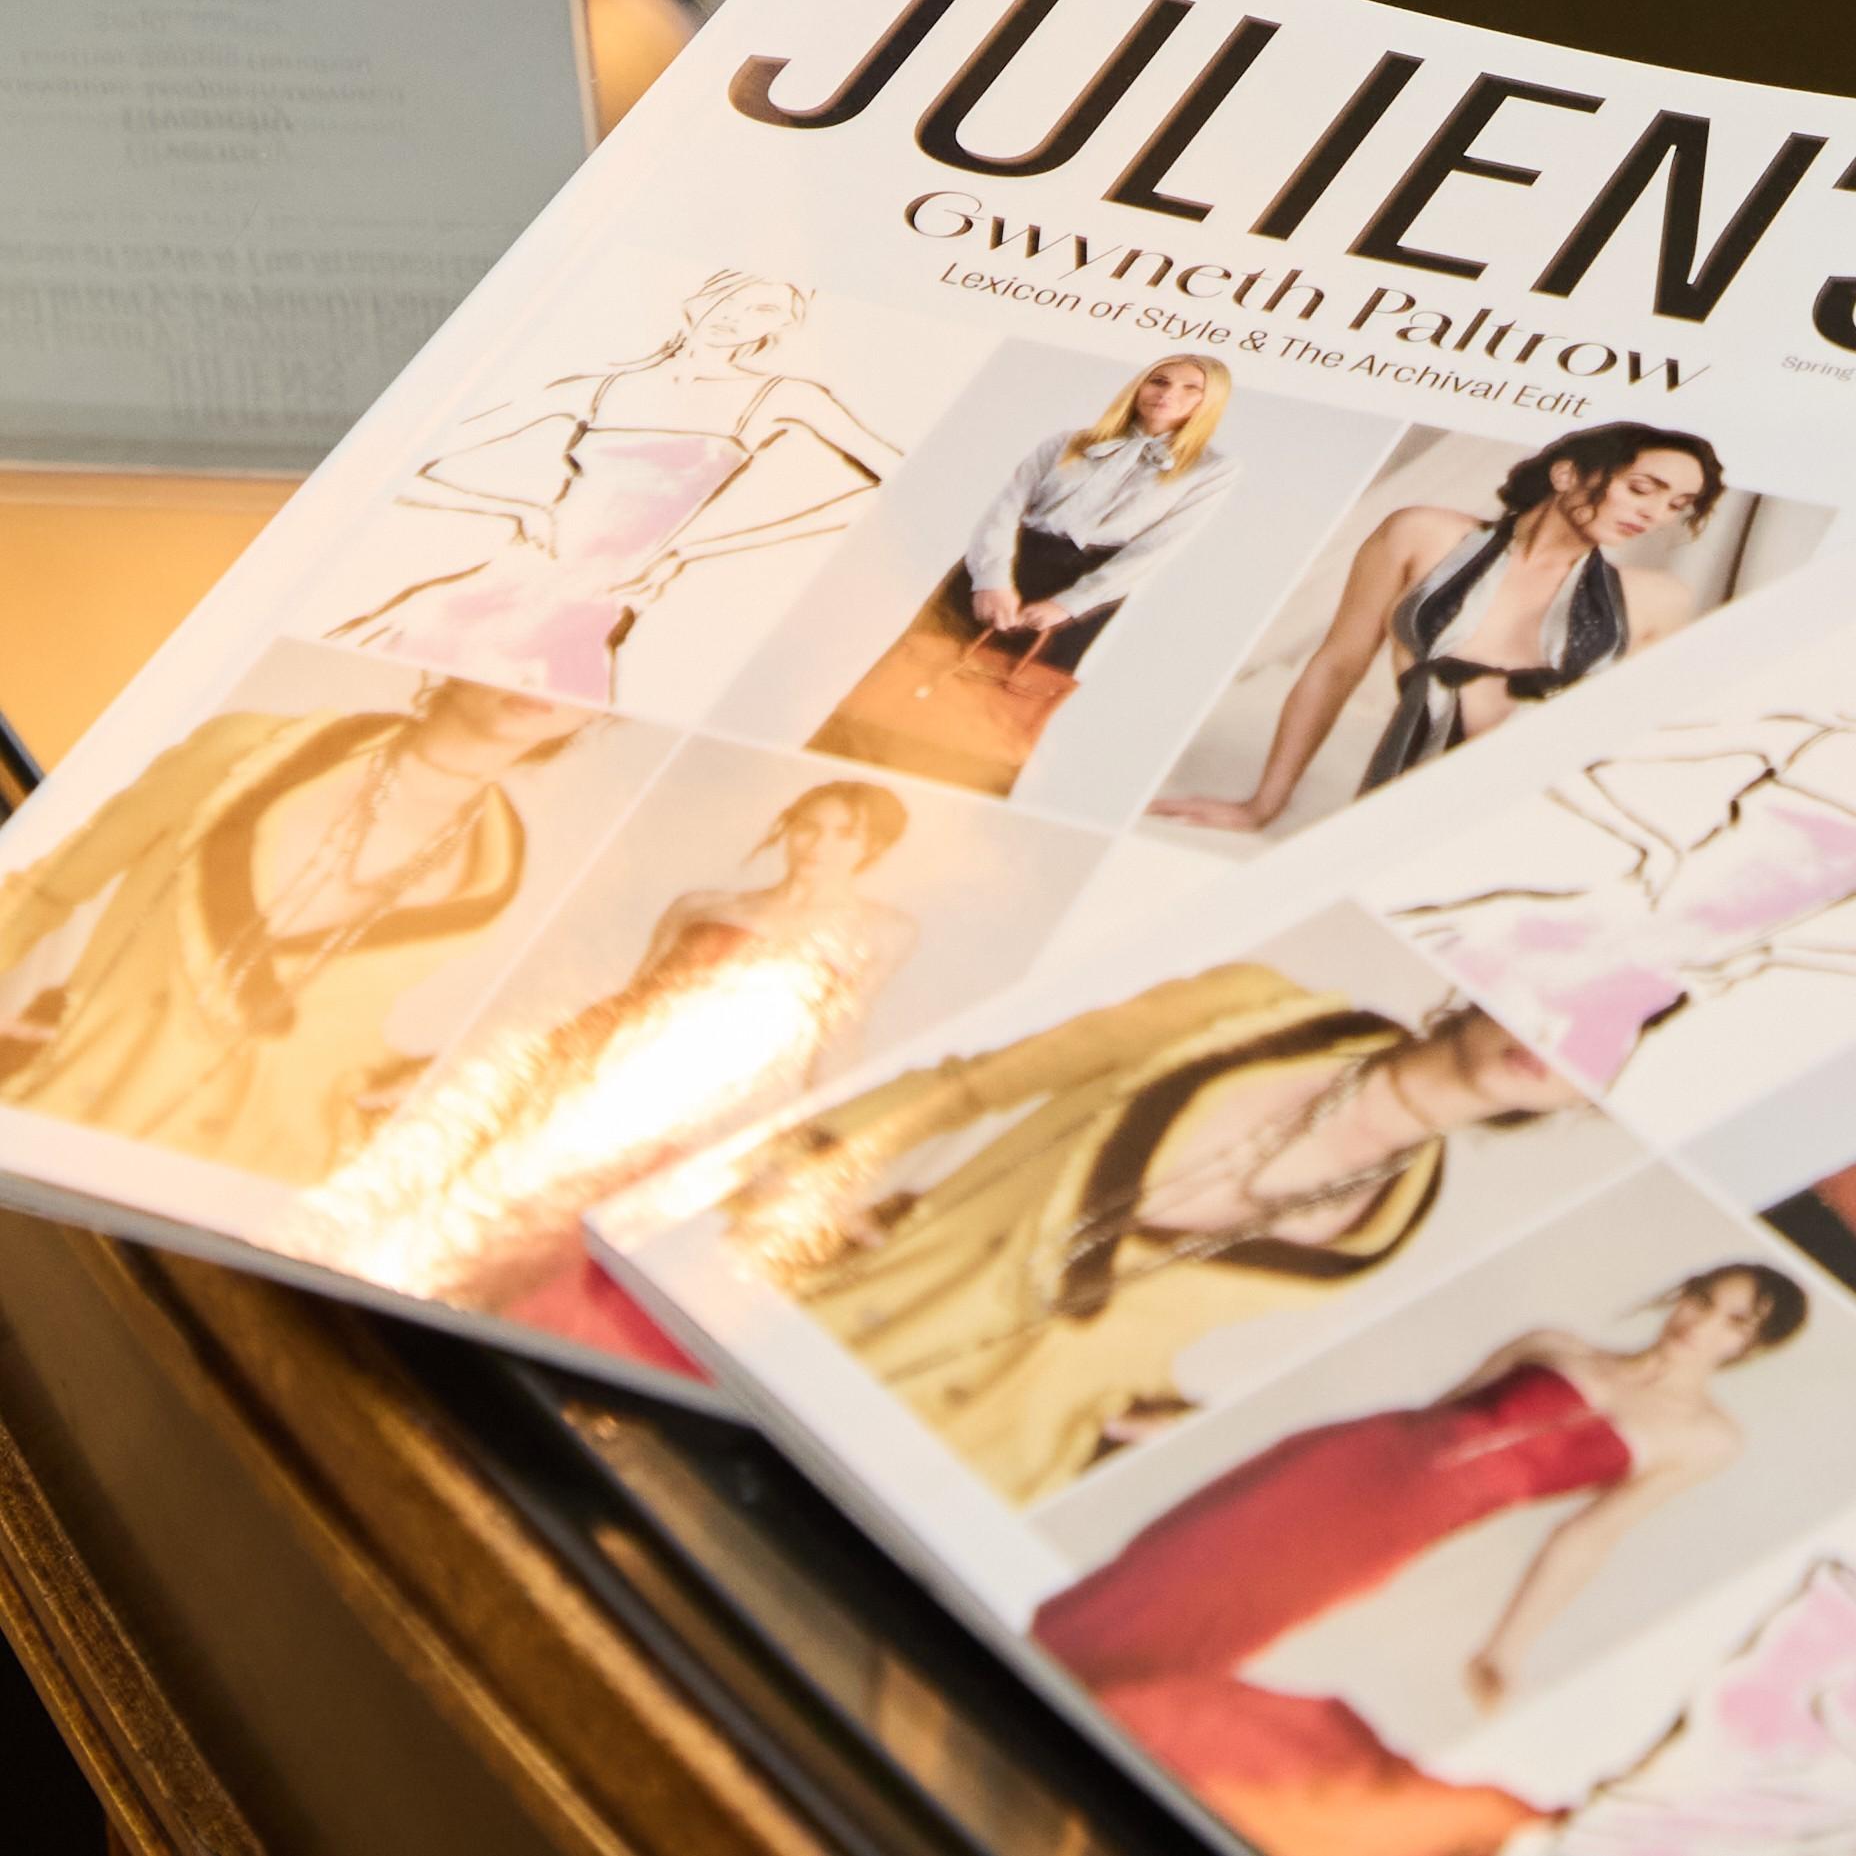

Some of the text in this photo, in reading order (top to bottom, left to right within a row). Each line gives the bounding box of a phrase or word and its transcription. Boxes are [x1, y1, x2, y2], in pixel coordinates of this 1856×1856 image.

[903, 190, 1712, 394] Gwyneth Paltrow
[939, 262, 1595, 419] Lexicon of Style & The Archival Edit
[1780, 354, 1856, 384] Spring
